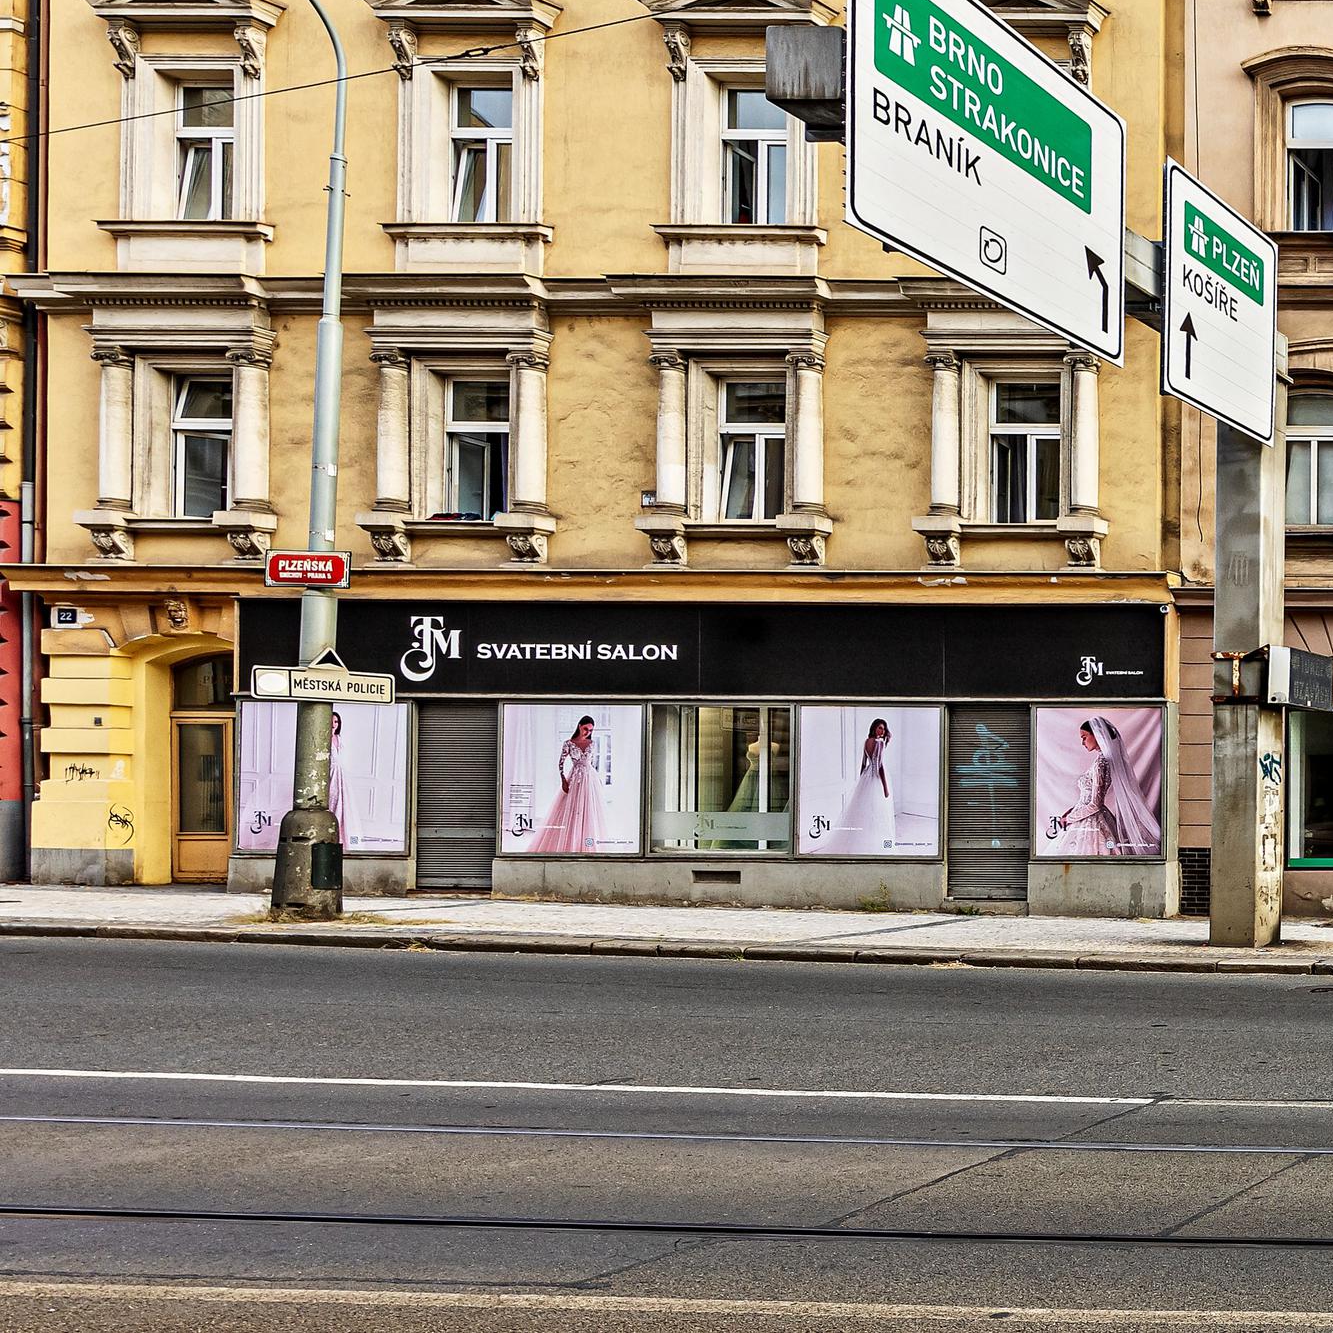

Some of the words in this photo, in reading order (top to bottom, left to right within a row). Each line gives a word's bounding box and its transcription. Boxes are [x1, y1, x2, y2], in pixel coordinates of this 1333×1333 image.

[929, 15, 1003, 95] BRNO
[873, 86, 982, 186] BRANÍK
[929, 65, 1084, 199] STRAKONICE
[1212, 235, 1260, 291] PLZEŇ
[1183, 264, 1238, 322] KOŠÍŘE
[278, 558, 333, 572] PLZEŇSKÁ
[60, 612, 72, 621] 22
[476, 640, 592, 660] SVATEBNÍ
[597, 644, 678, 661] SALON
[293, 677, 341, 692] MĚSTSKÁ
[347, 682, 385, 695] POLICIE
